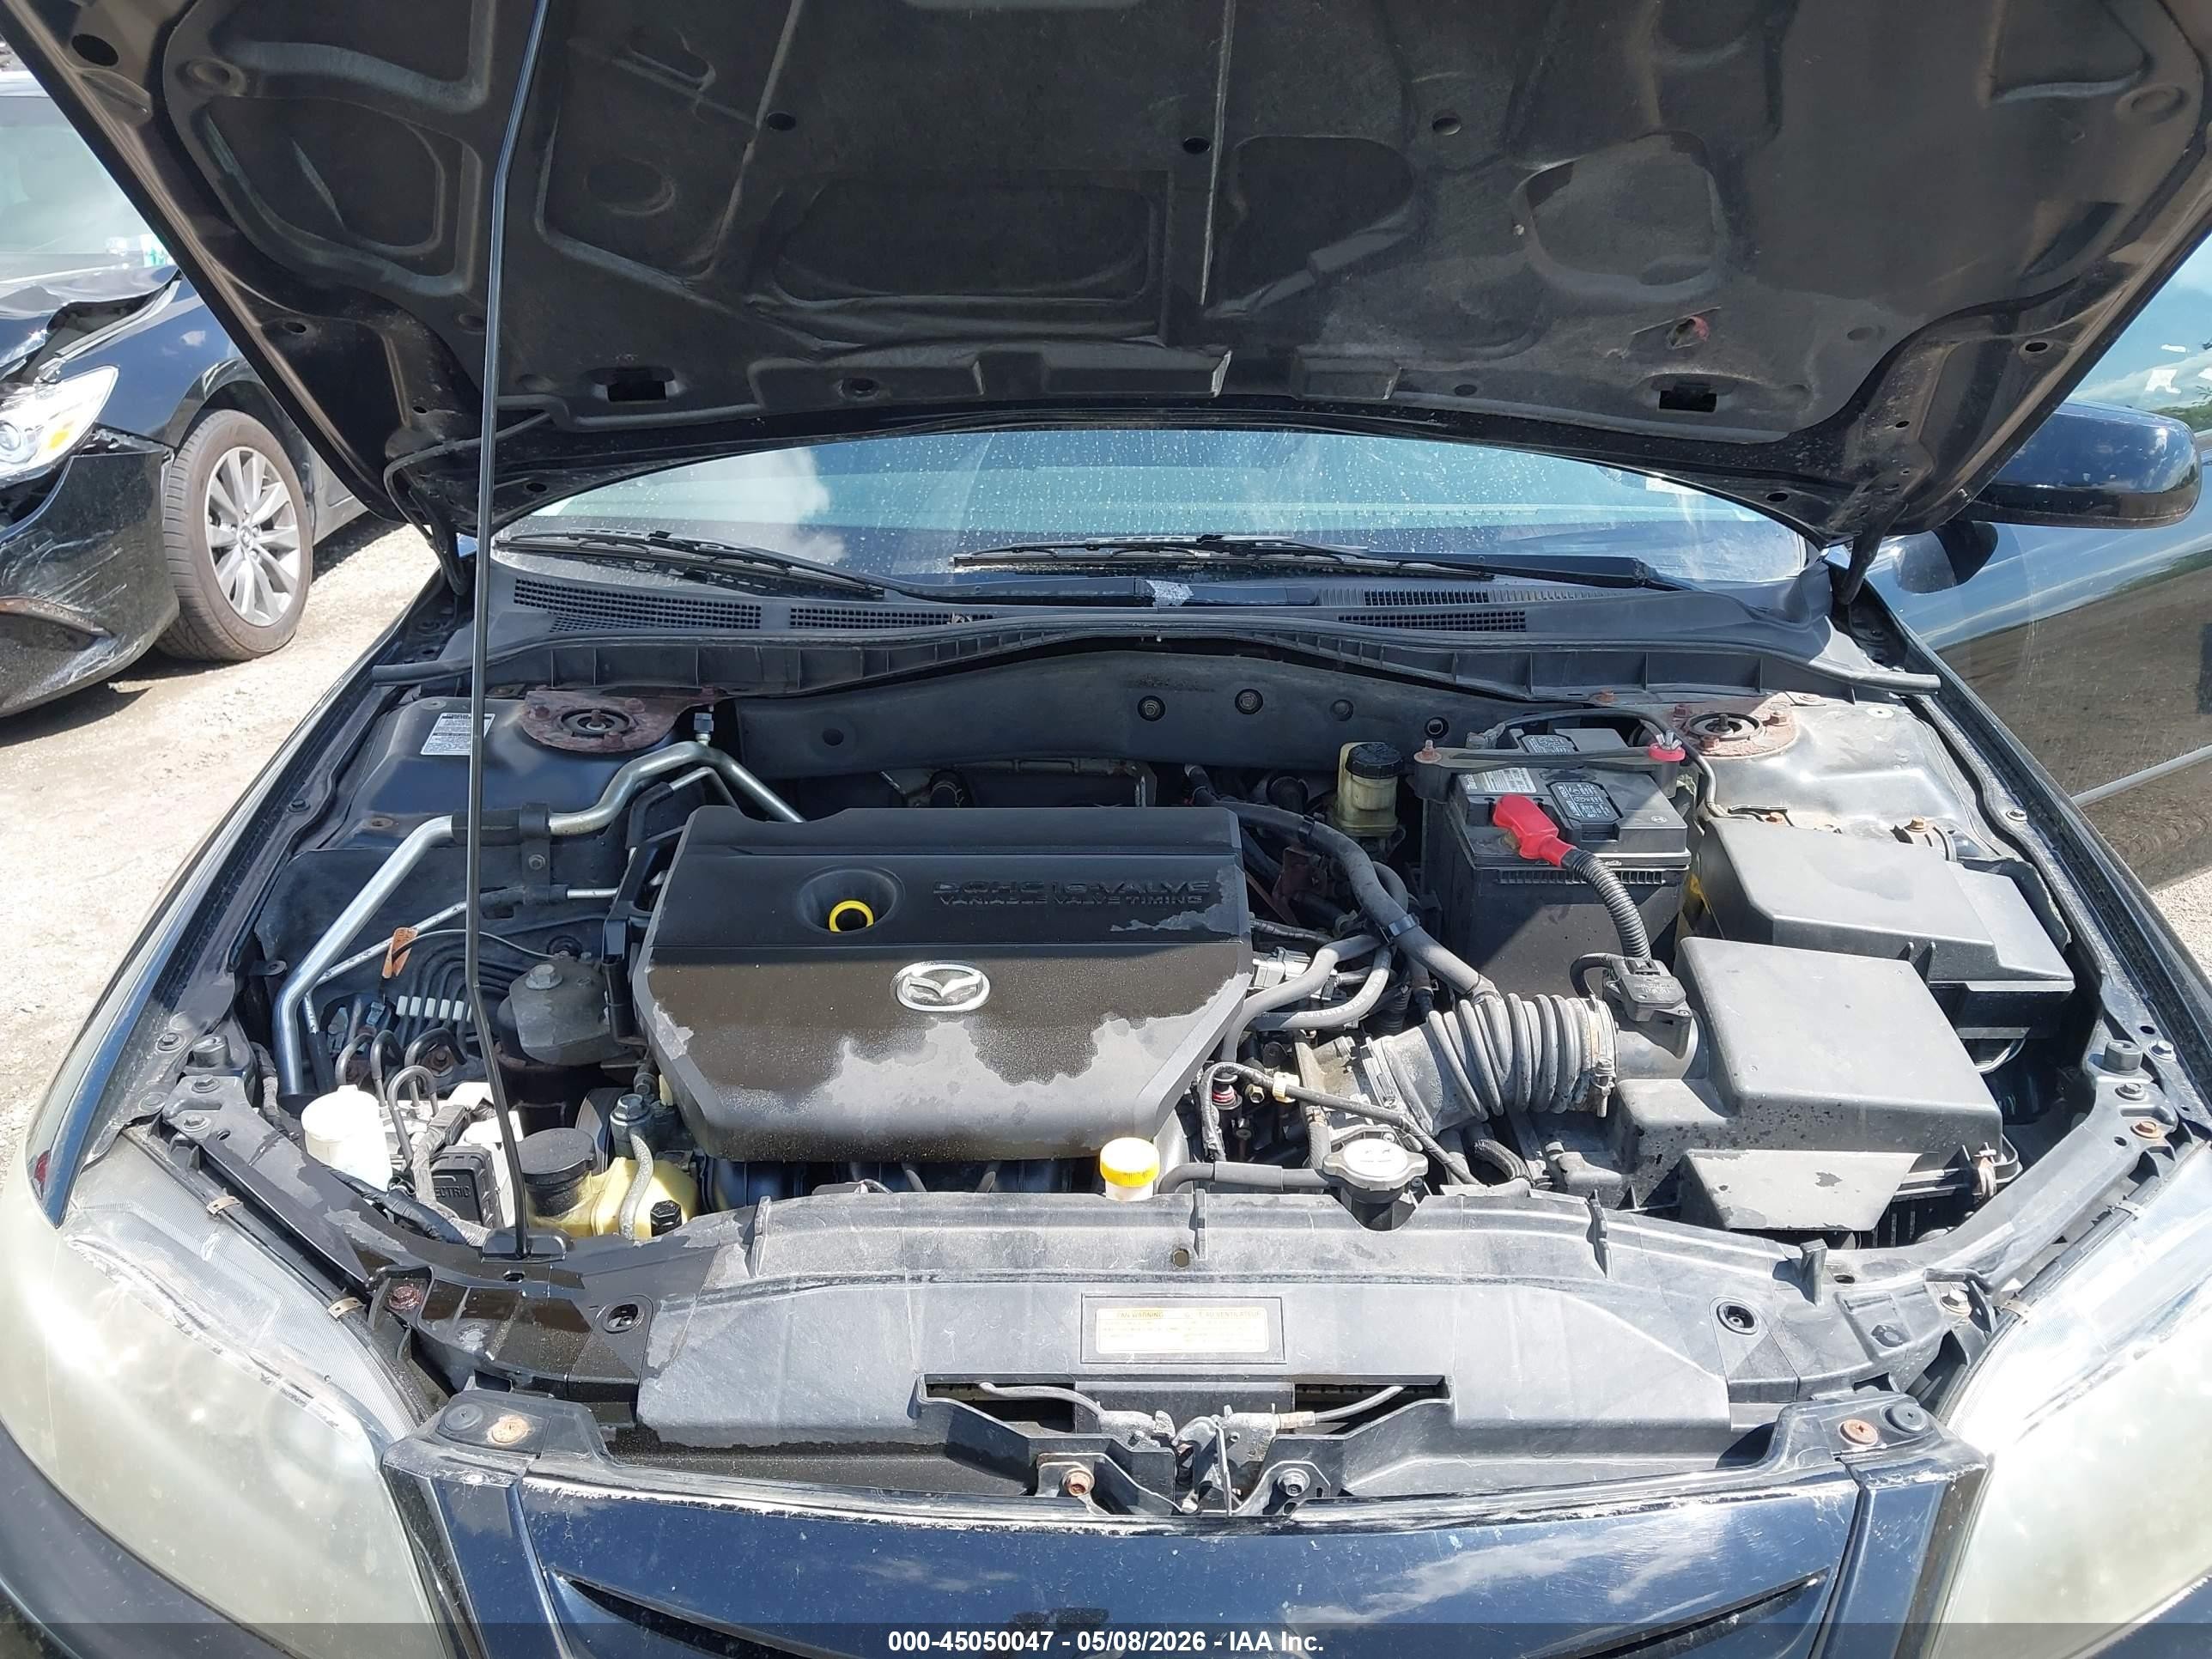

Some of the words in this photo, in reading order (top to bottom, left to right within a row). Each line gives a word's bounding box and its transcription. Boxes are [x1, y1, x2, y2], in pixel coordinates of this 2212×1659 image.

[933, 879, 1045, 895] DOHC
[1054, 896, 1121, 906] VALVE
[1125, 896, 1203, 906] TIMING
[1132, 1310, 1164, 1319] WARNING
